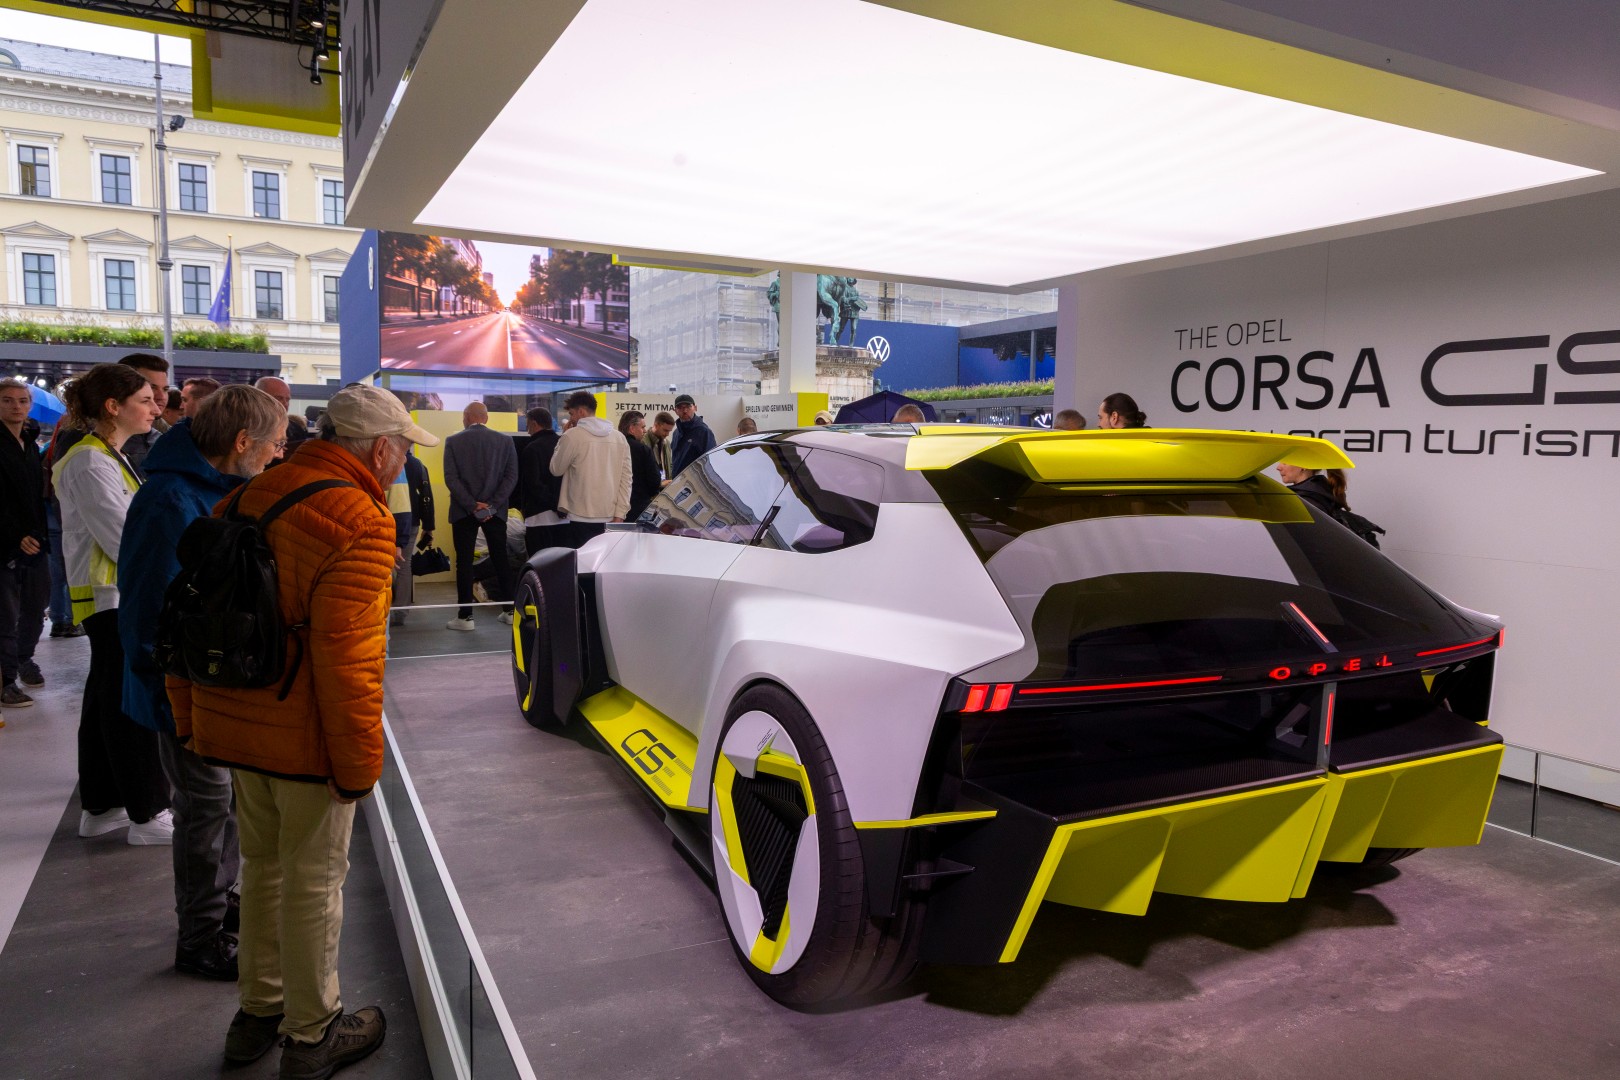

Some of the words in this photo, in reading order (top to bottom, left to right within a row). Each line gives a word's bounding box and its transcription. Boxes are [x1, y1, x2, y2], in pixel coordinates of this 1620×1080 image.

[1174, 325, 1219, 351] THE
[1226, 318, 1292, 347] OPEL
[1170, 347, 1391, 413] CORSA
[615, 402, 642, 411] JETZT
[745, 405, 761, 413] SPIELEN
[770, 404, 794, 412] GEWINNEN
[1268, 655, 1393, 681] OPEL
